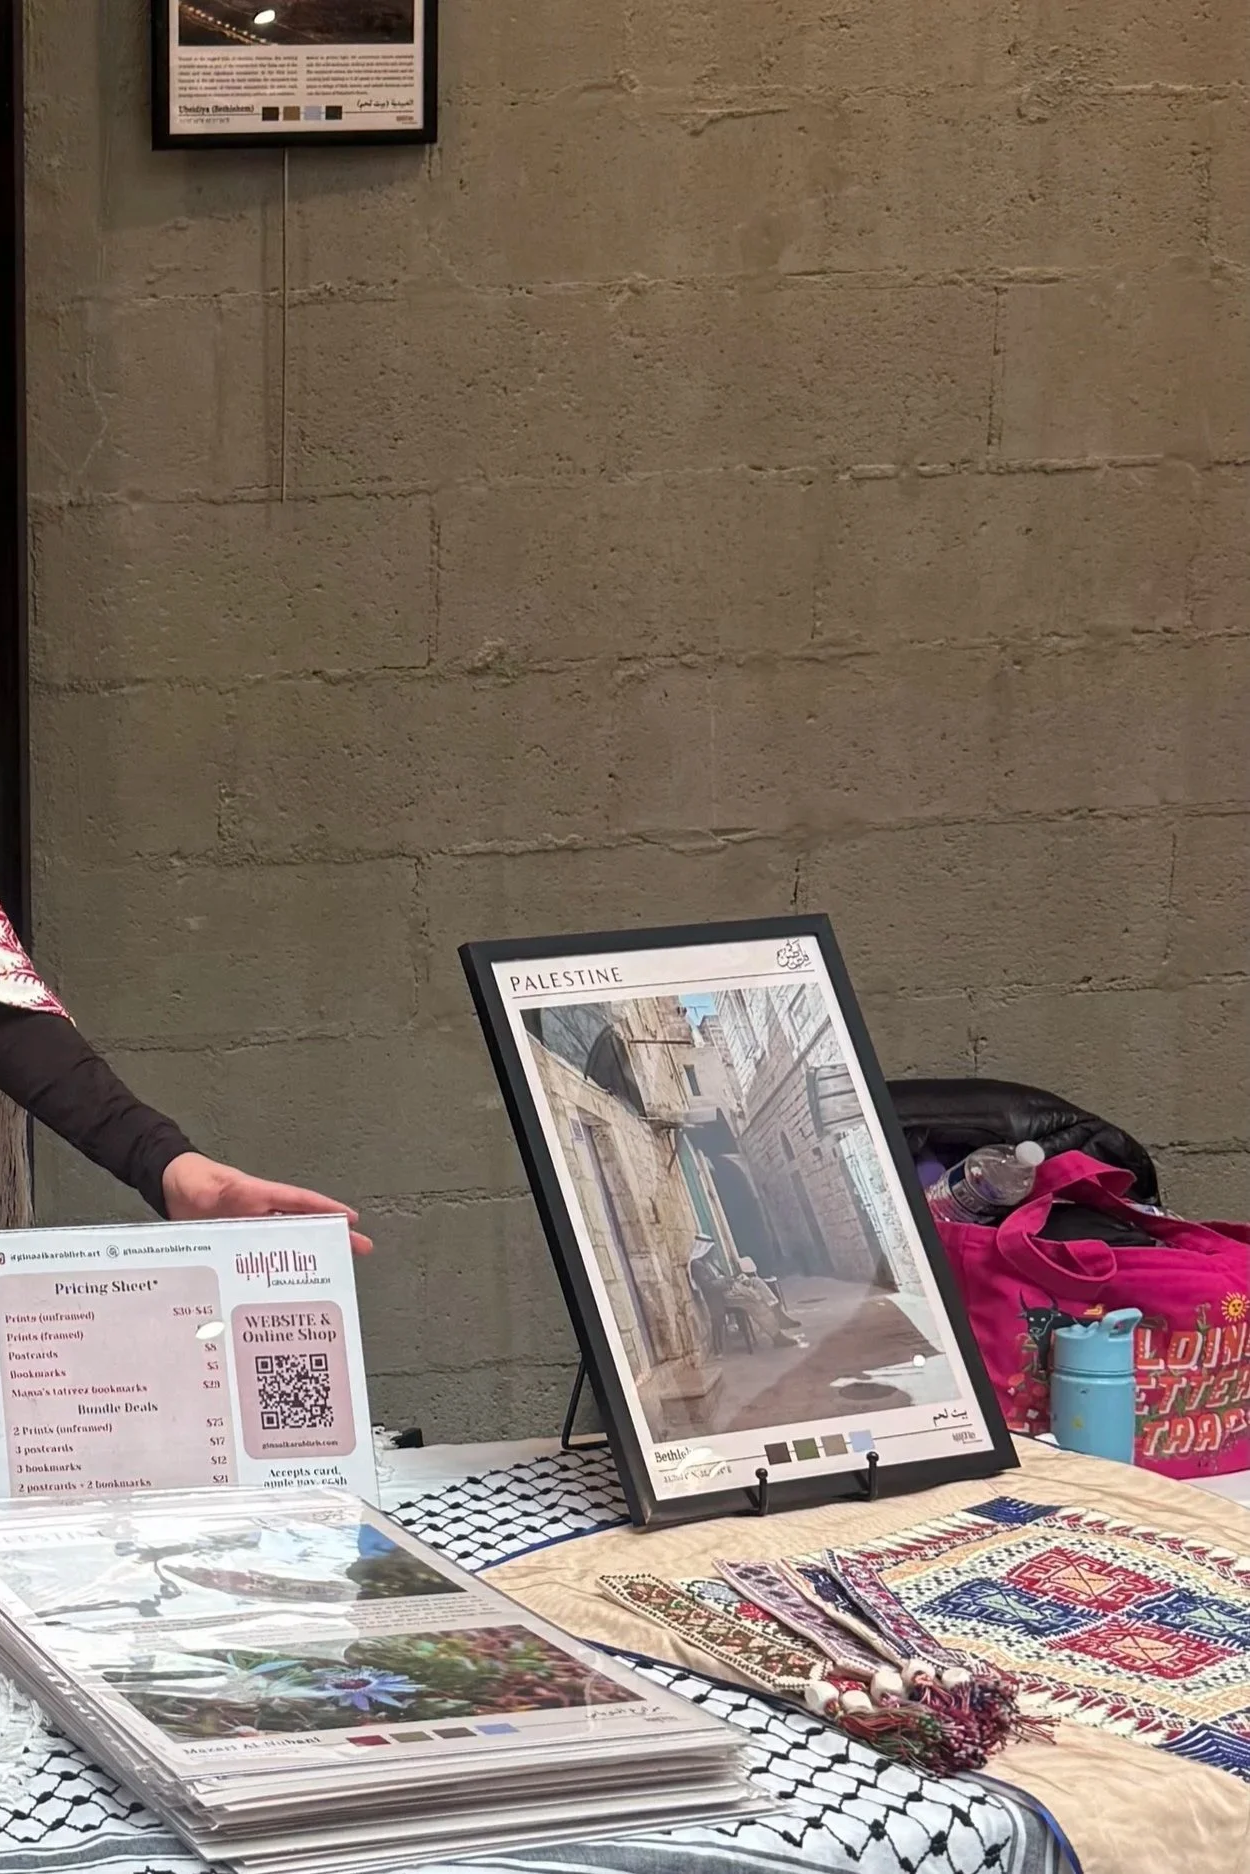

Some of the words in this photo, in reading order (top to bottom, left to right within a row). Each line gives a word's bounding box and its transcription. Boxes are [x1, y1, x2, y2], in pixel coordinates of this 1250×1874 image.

[509, 967, 623, 992] PALESTINE
[54, 1282, 109, 1296] Pricing
[5, 1313, 37, 1324] Prints
[39, 1311, 95, 1324] (unframed)
[245, 1313, 317, 1328] WEBSITE
[321, 1313, 332, 1326] &
[6, 1332, 38, 1343] Prints
[40, 1330, 84, 1342] (framed)
[243, 1330, 294, 1343] Online
[297, 1327, 337, 1343] Shop
[8, 1350, 59, 1361] Postcards
[10, 1369, 66, 1380] Bookmarks
[11, 1387, 51, 1398] Mama's
[91, 1384, 148, 1394] bookmarks
[78, 1403, 121, 1415] Bundle
[125, 1402, 158, 1413] Deals
[13, 1427, 20, 1436] 2
[22, 1425, 54, 1435] Prints
[56, 1423, 113, 1435] (unframed)
[24, 1444, 74, 1456] postcards
[25, 1463, 82, 1473] bookmarks
[269, 1467, 311, 1479] Accepts
[18, 1484, 25, 1492] 2
[27, 1482, 77, 1494] postcards
[87, 1480, 93, 1489] 2
[95, 1478, 152, 1488] bookmarks
